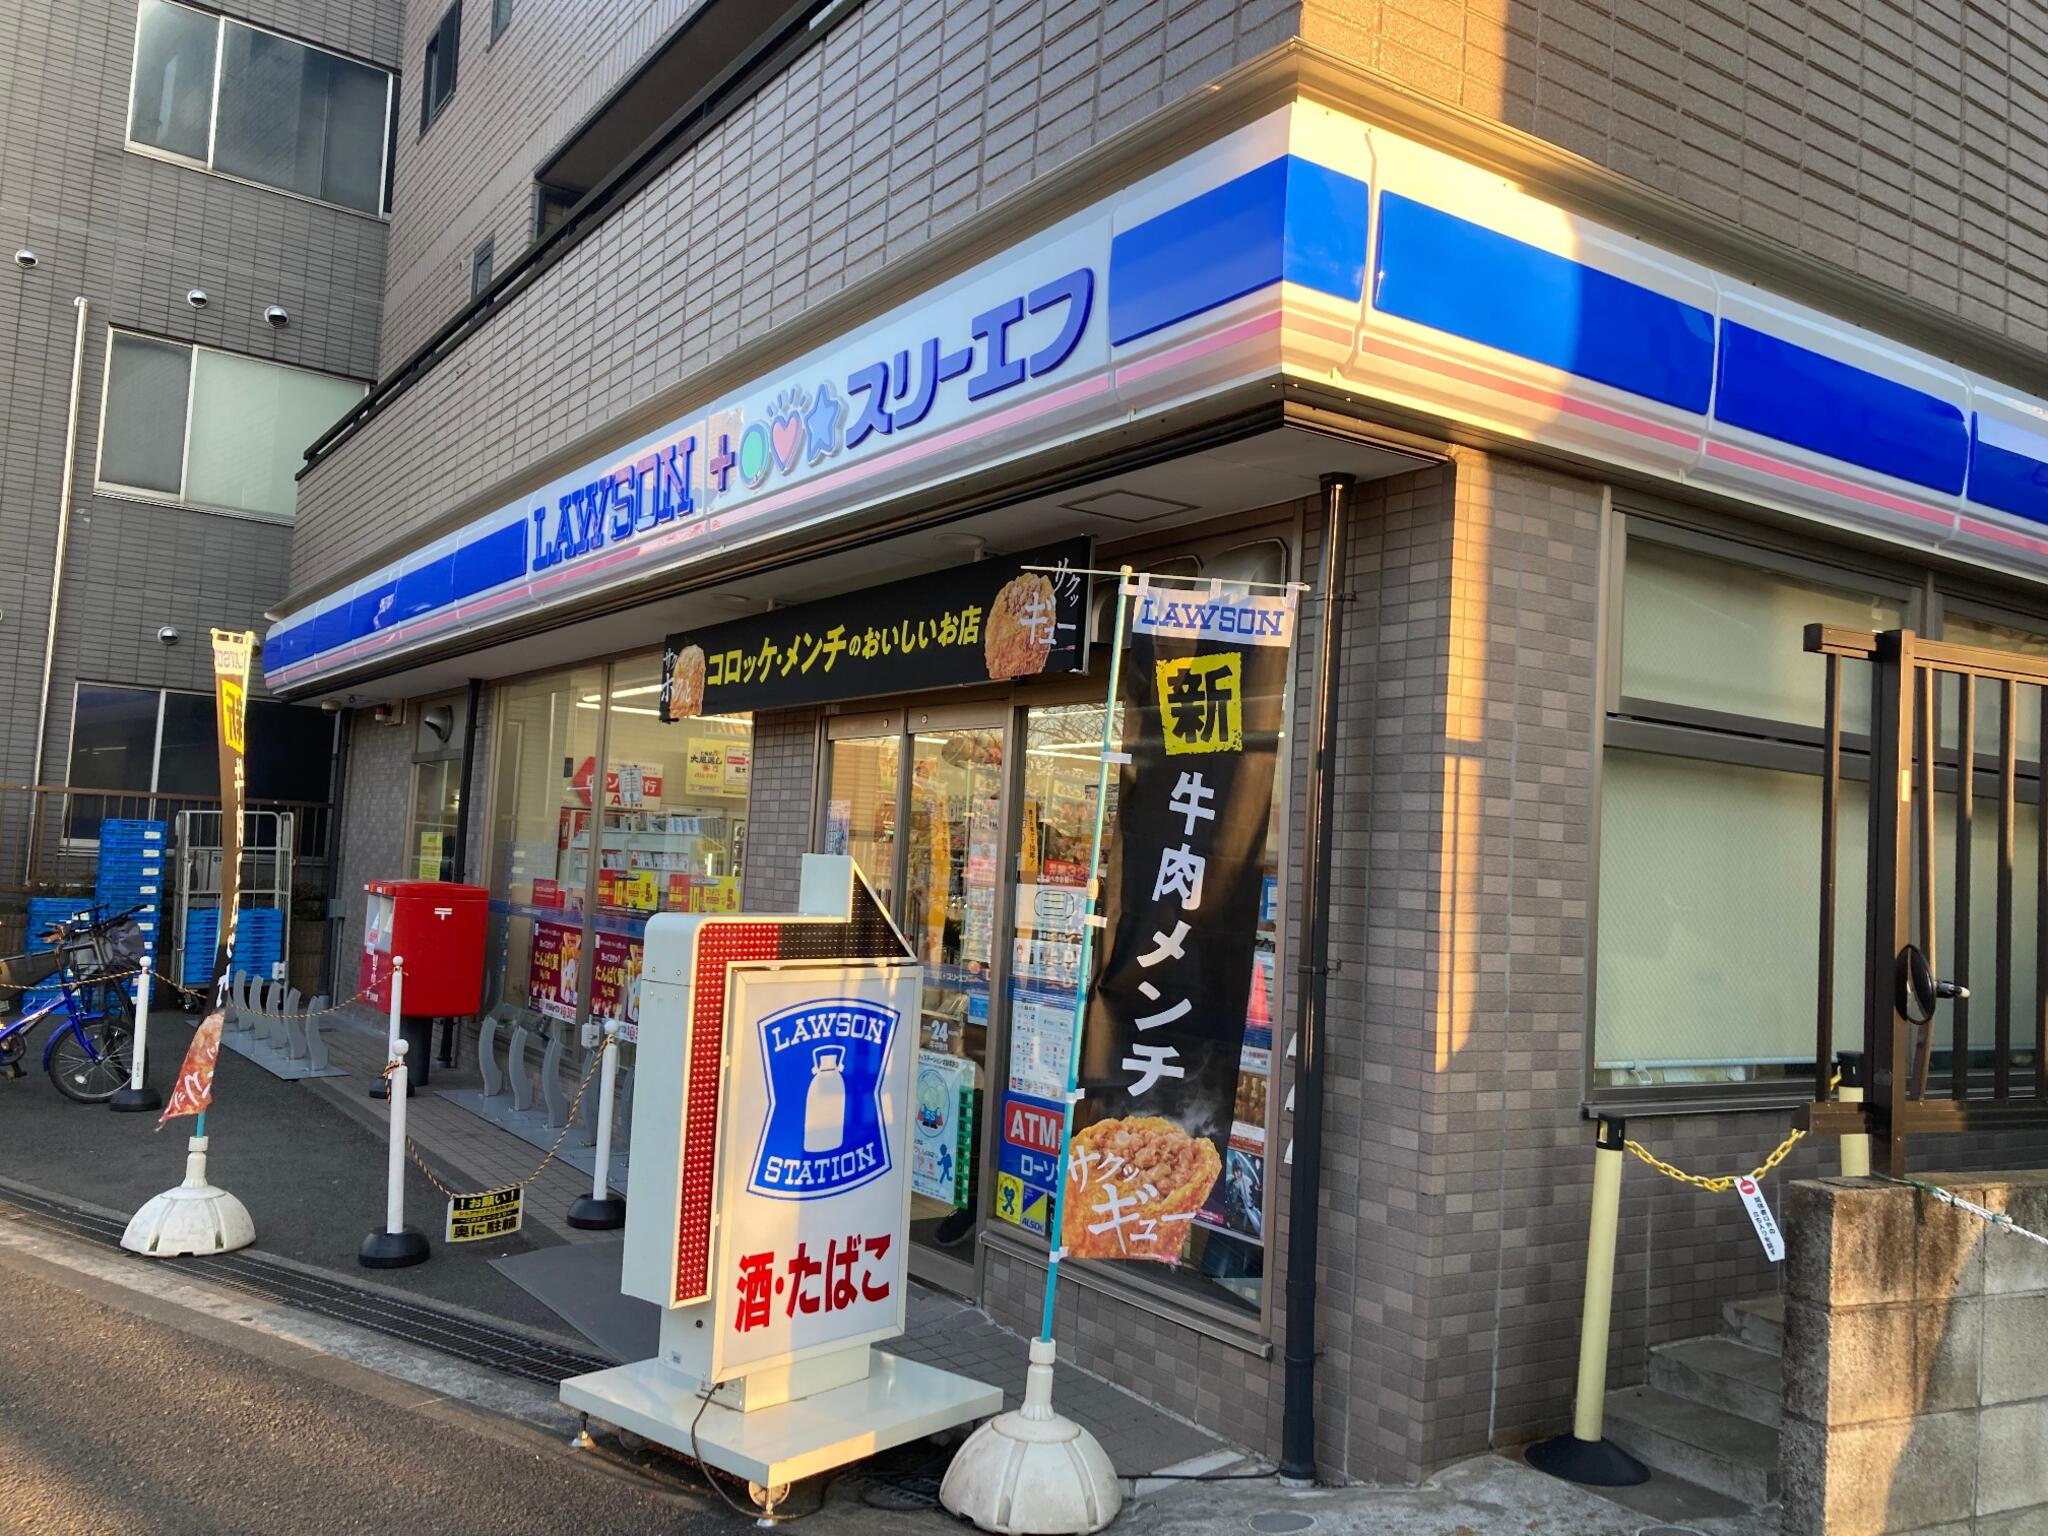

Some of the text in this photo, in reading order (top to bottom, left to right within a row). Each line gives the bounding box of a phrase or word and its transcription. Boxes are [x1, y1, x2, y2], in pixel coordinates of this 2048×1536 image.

[532, 436, 696, 571] LAWSON
[846, 267, 1095, 449] スリーエフ
[1141, 599, 1284, 637] LAWSON
[707, 605, 982, 686] コロッケ・メンチのおいしいお店
[1166, 664, 1233, 744] 新
[1122, 771, 1216, 1097] 牛肉メンチ
[772, 1012, 887, 1053] LAWSON
[931, 1019, 949, 1042] 24
[1010, 1110, 1057, 1149] ATM
[763, 1141, 877, 1186] STATION
[1021, 1154, 1059, 1183] ローソ
[1068, 1145, 1140, 1193] サクッ
[1088, 1183, 1196, 1255] ギュー
[734, 1234, 891, 1333] 酒・たばこ
